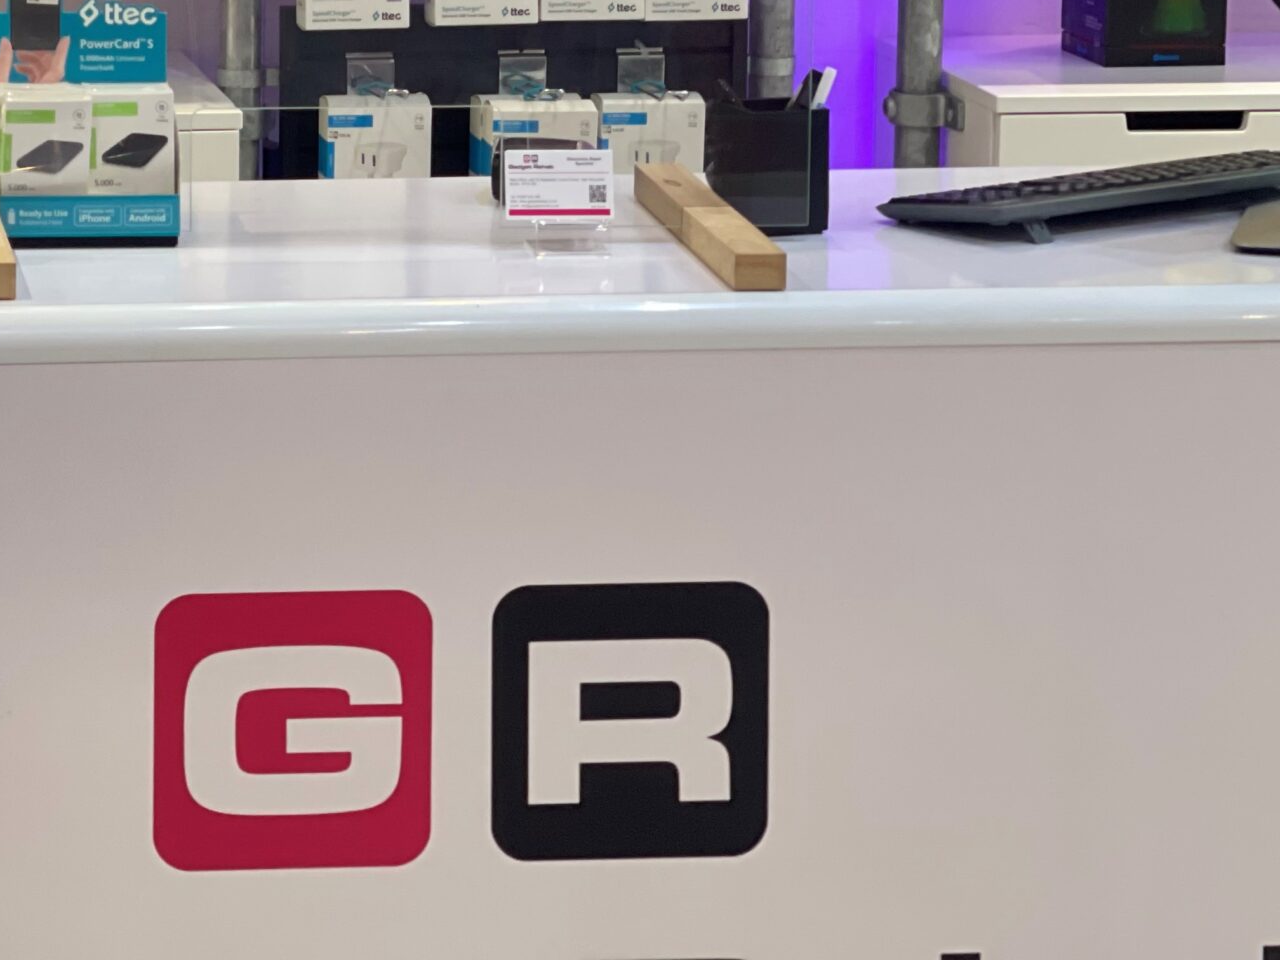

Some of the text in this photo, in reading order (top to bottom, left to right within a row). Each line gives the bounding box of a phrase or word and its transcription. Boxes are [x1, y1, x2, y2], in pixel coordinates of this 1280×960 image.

[104, 3, 158, 25] ttec
[147, 38, 154, 49] S
[19, 209, 68, 218] Ready to Use
[79, 214, 111, 223] iPhone
[129, 213, 167, 223] Android
